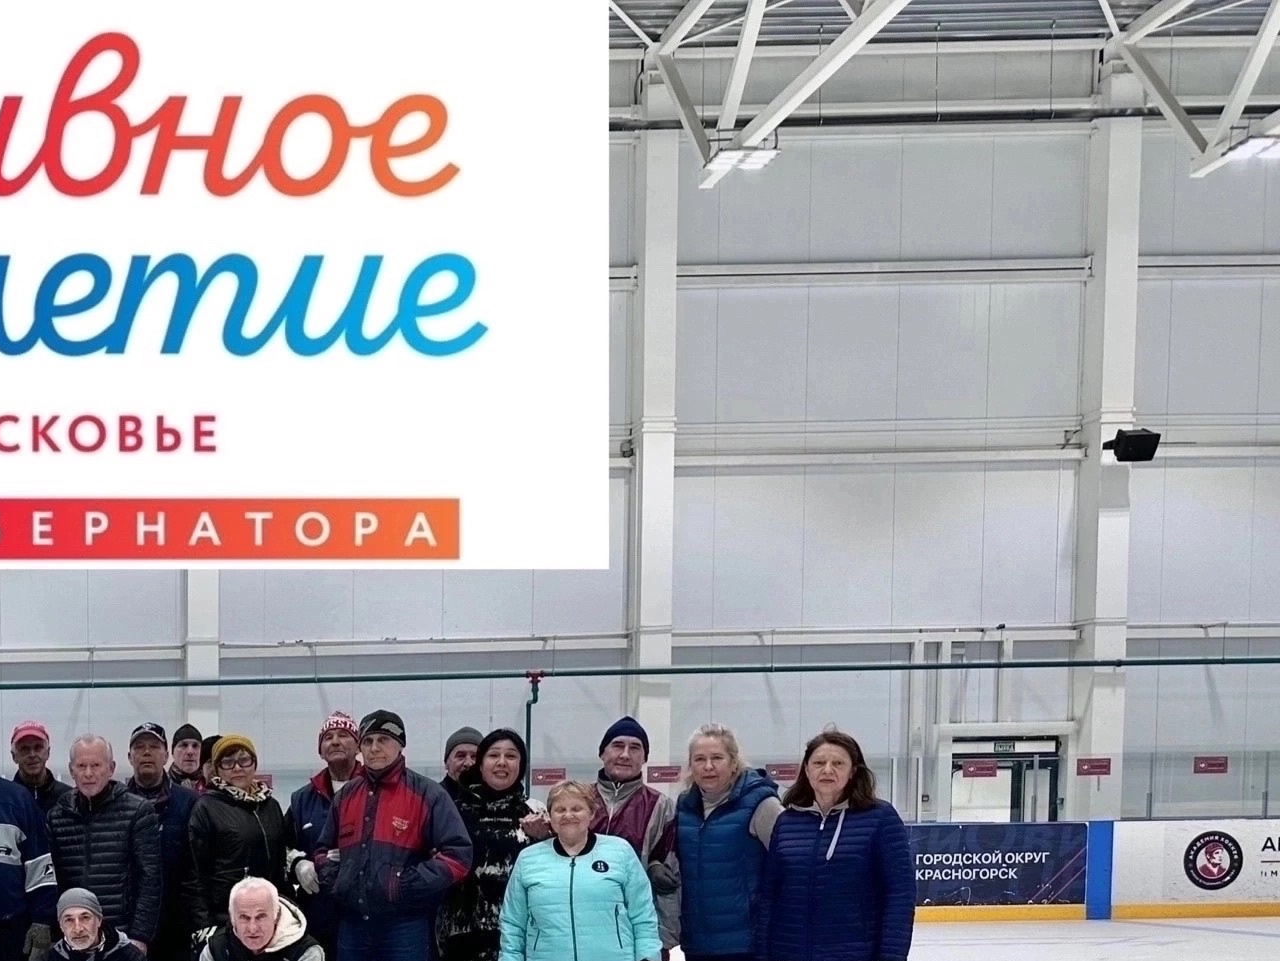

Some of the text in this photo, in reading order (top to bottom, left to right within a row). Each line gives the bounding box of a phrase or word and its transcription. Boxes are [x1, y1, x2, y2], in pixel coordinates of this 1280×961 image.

[915, 850, 1050, 866] ГОРОДСКОЙ ОКРУГ
[915, 867, 1018, 880] КРАСНОГОРСК
